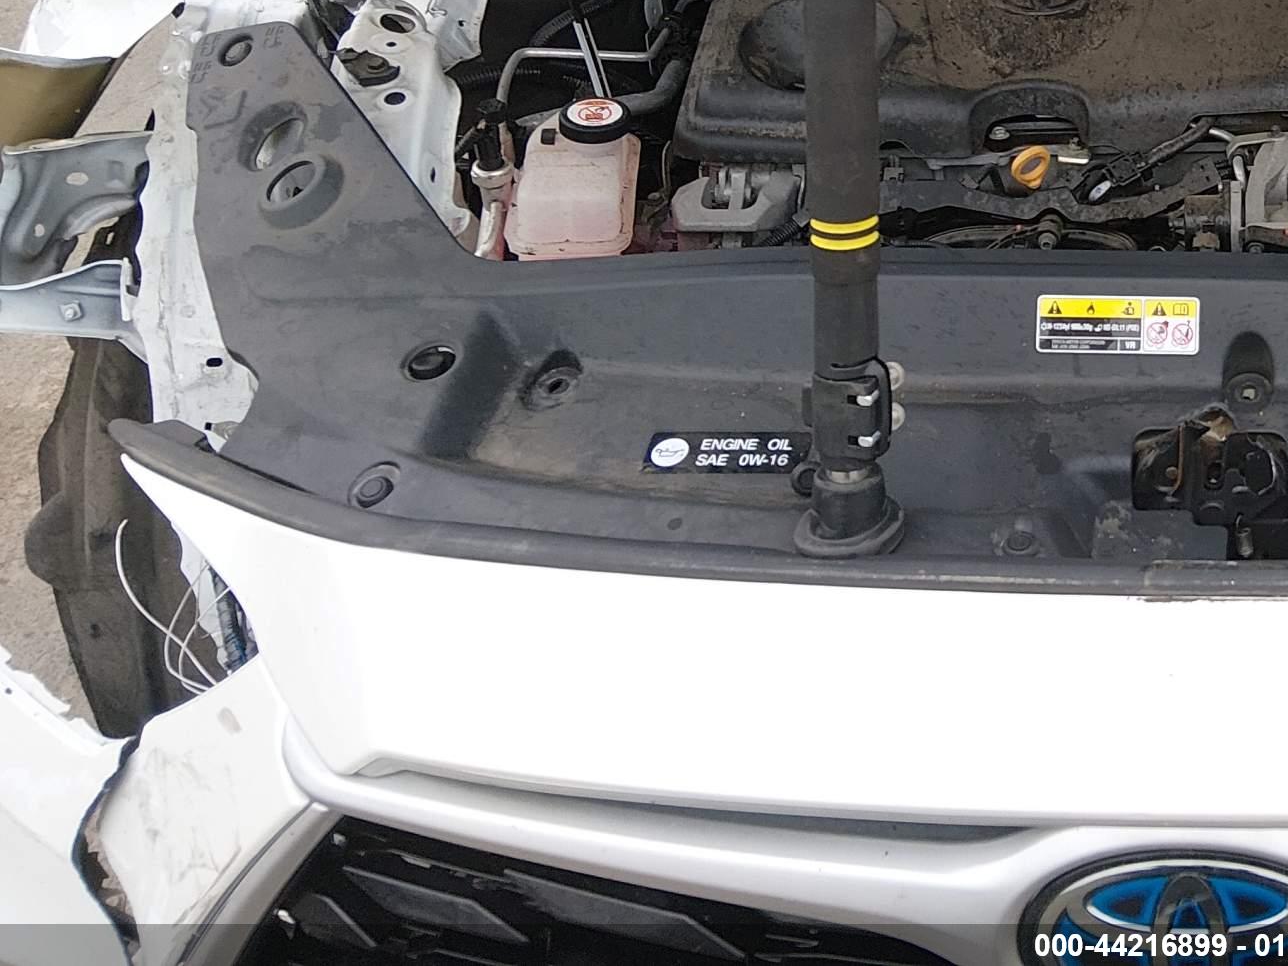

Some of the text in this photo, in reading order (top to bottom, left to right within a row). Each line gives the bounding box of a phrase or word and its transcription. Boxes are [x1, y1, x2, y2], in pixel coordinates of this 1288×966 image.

[700, 438, 793, 451] ENGINE OIL
[695, 454, 789, 467] SAE 0W-16
